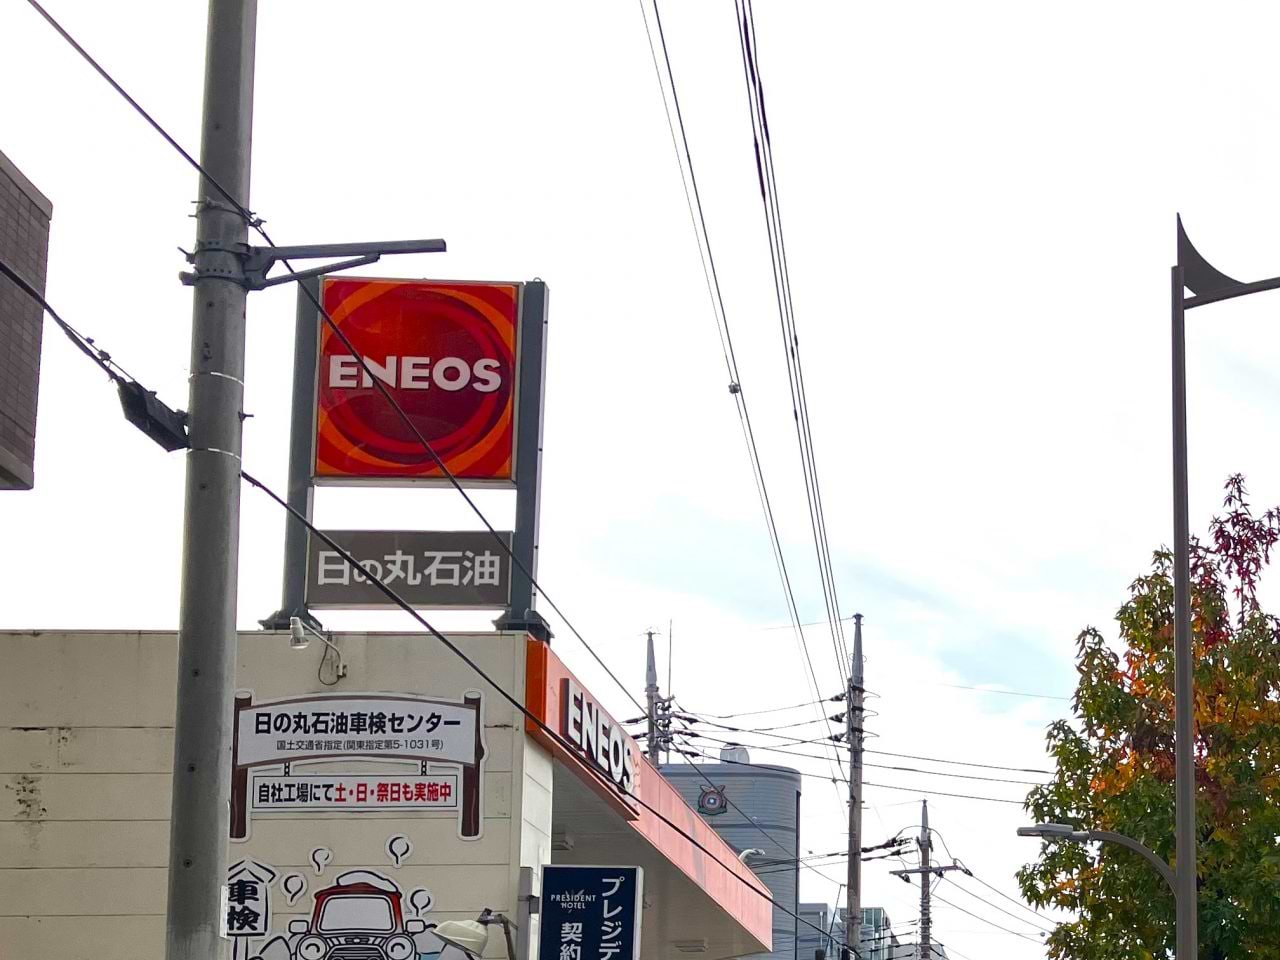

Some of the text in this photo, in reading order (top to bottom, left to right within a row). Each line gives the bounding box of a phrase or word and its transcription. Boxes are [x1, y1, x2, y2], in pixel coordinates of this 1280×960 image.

[329, 355, 502, 392] ENEOS
[317, 550, 501, 586] 日の丸石油
[254, 711, 462, 735] 日の丸石油車検センター
[566, 678, 635, 795] ENEOS
[276, 739, 444, 751] 国土交通省指定(関東指定第5-1031号)
[228, 879, 261, 931] 車検
[550, 894, 597, 902] PRESIDENT
[560, 901, 586, 910] HOTEL
